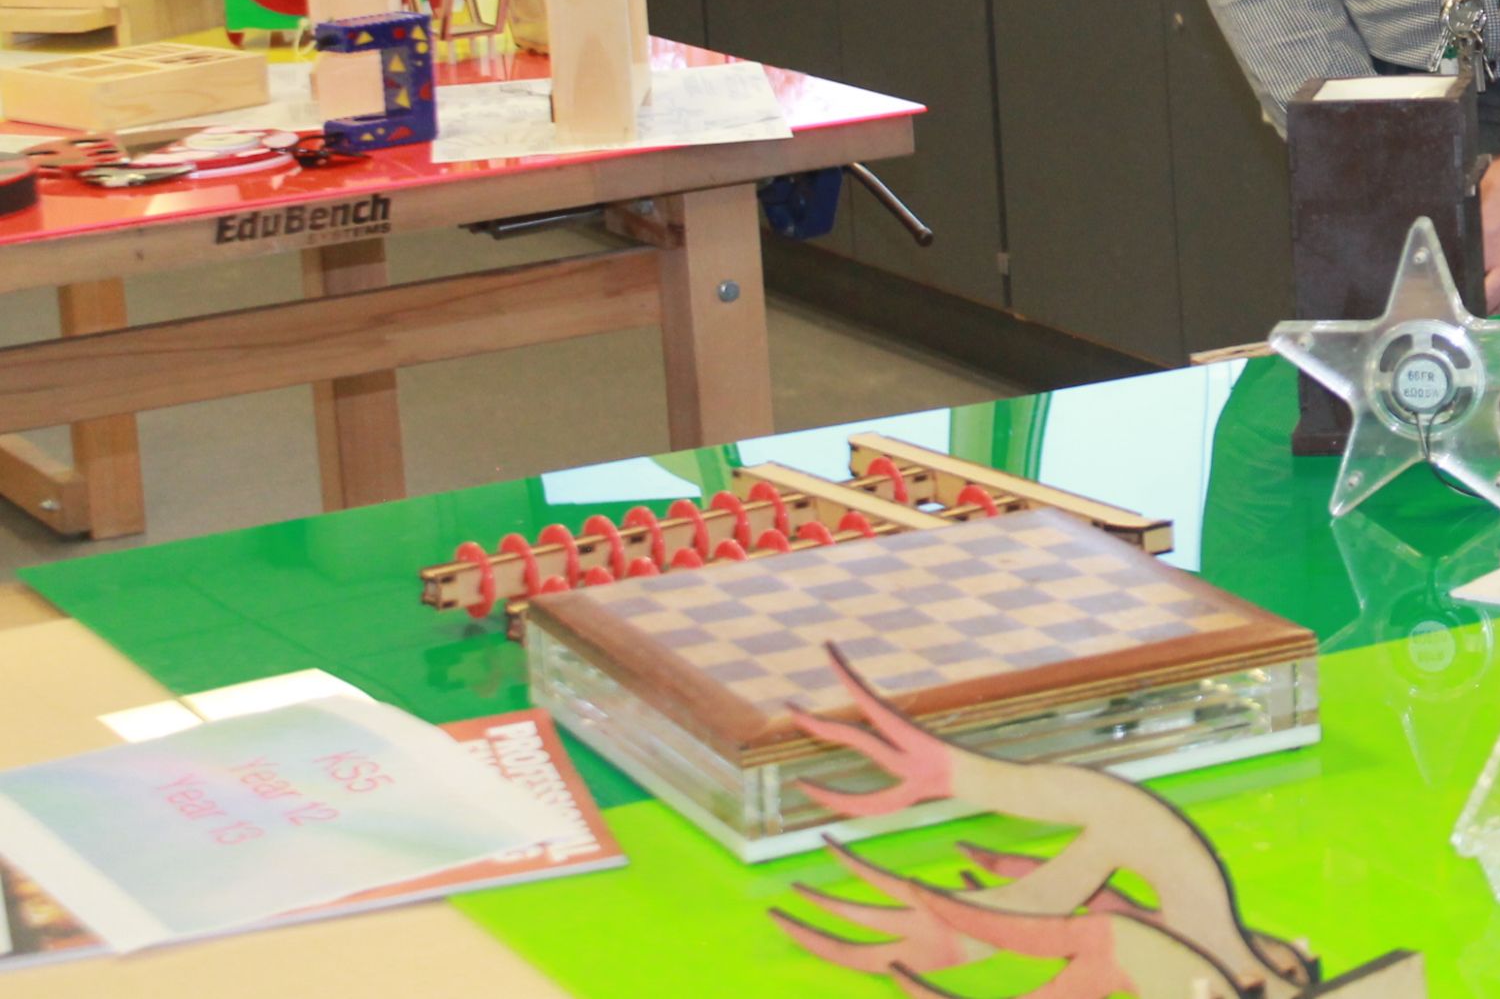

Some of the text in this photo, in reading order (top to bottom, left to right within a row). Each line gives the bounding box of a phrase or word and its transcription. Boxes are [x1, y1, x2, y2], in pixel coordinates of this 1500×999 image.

[215, 193, 392, 244] EduBench
[228, 756, 341, 826] Year 12
[312, 750, 395, 793] KS5
[155, 774, 265, 846] Year 13
